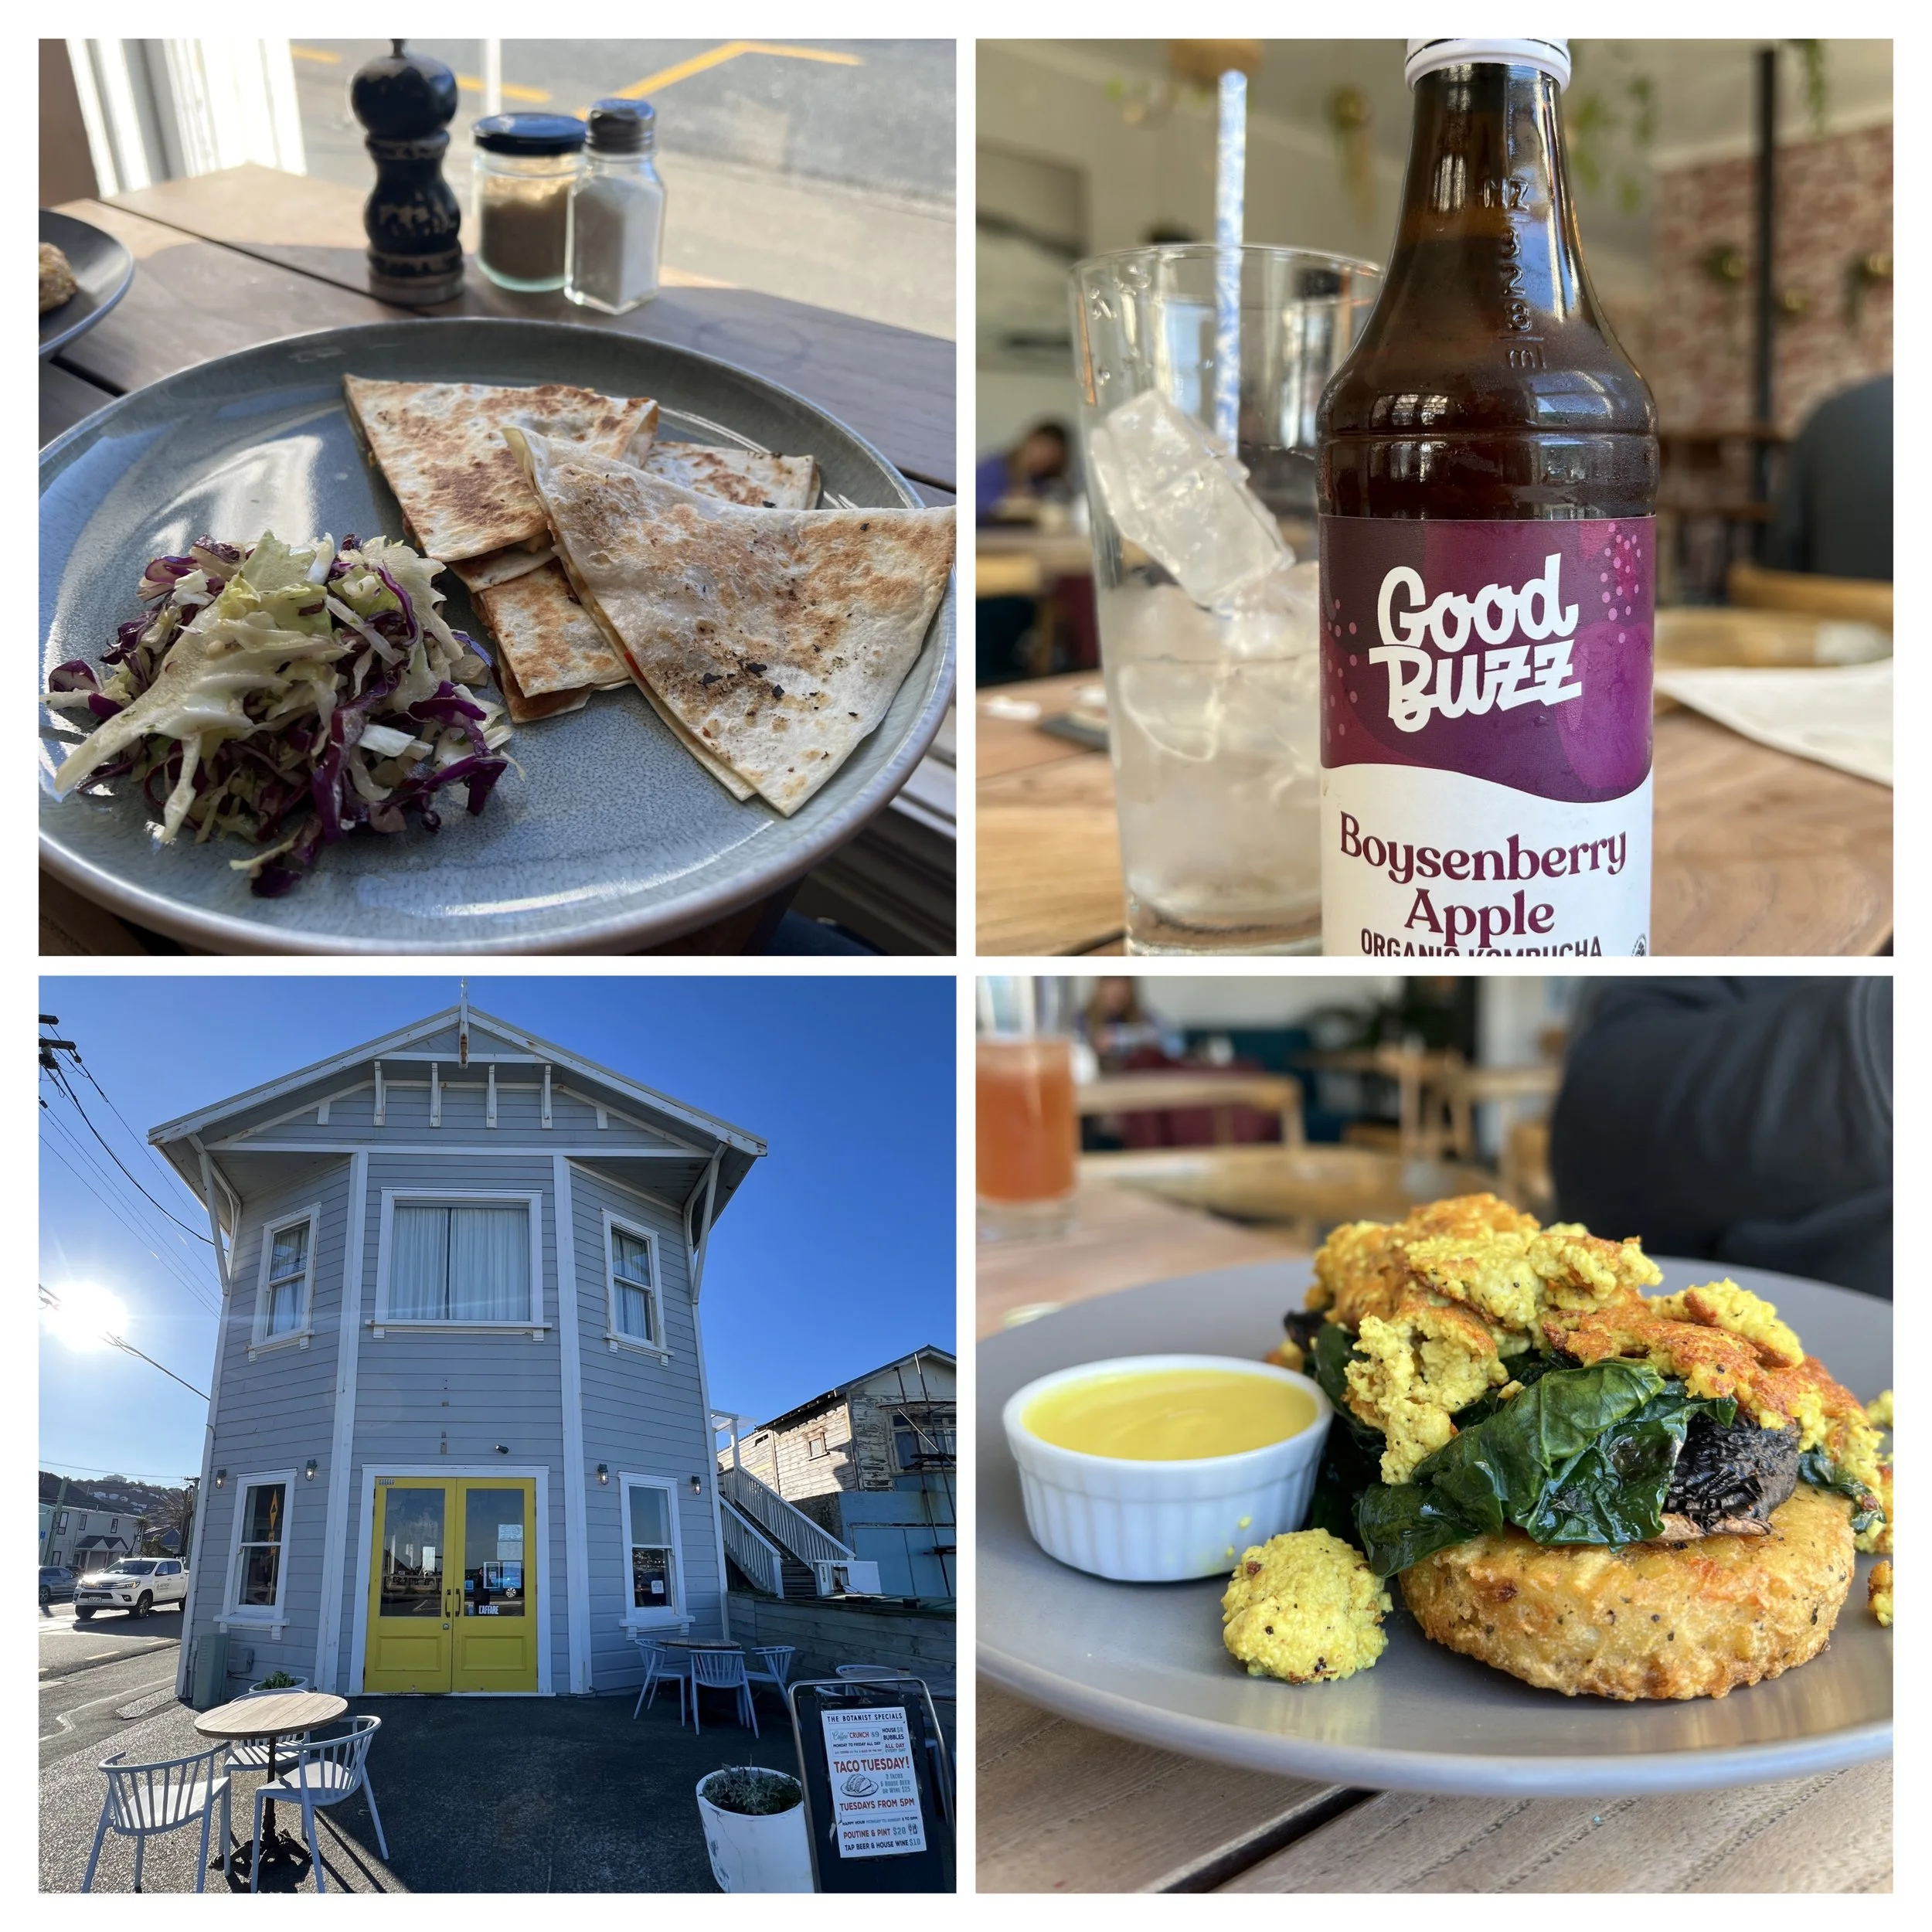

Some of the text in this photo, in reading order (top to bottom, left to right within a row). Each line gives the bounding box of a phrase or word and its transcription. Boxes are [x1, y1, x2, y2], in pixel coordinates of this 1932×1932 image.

[1377, 553, 1579, 653] Good
[1340, 811, 1627, 884] Boysenberry
[1404, 887, 1555, 949] Apple
[833, 1756, 910, 1773] TACO TUESDAY!
[839, 1798, 915, 1811] TUESDAYS FROM 5PM
[843, 1829, 869, 1839] POUTINE
[893, 1826, 906, 1835] $20
[910, 1838, 921, 1846] $10
